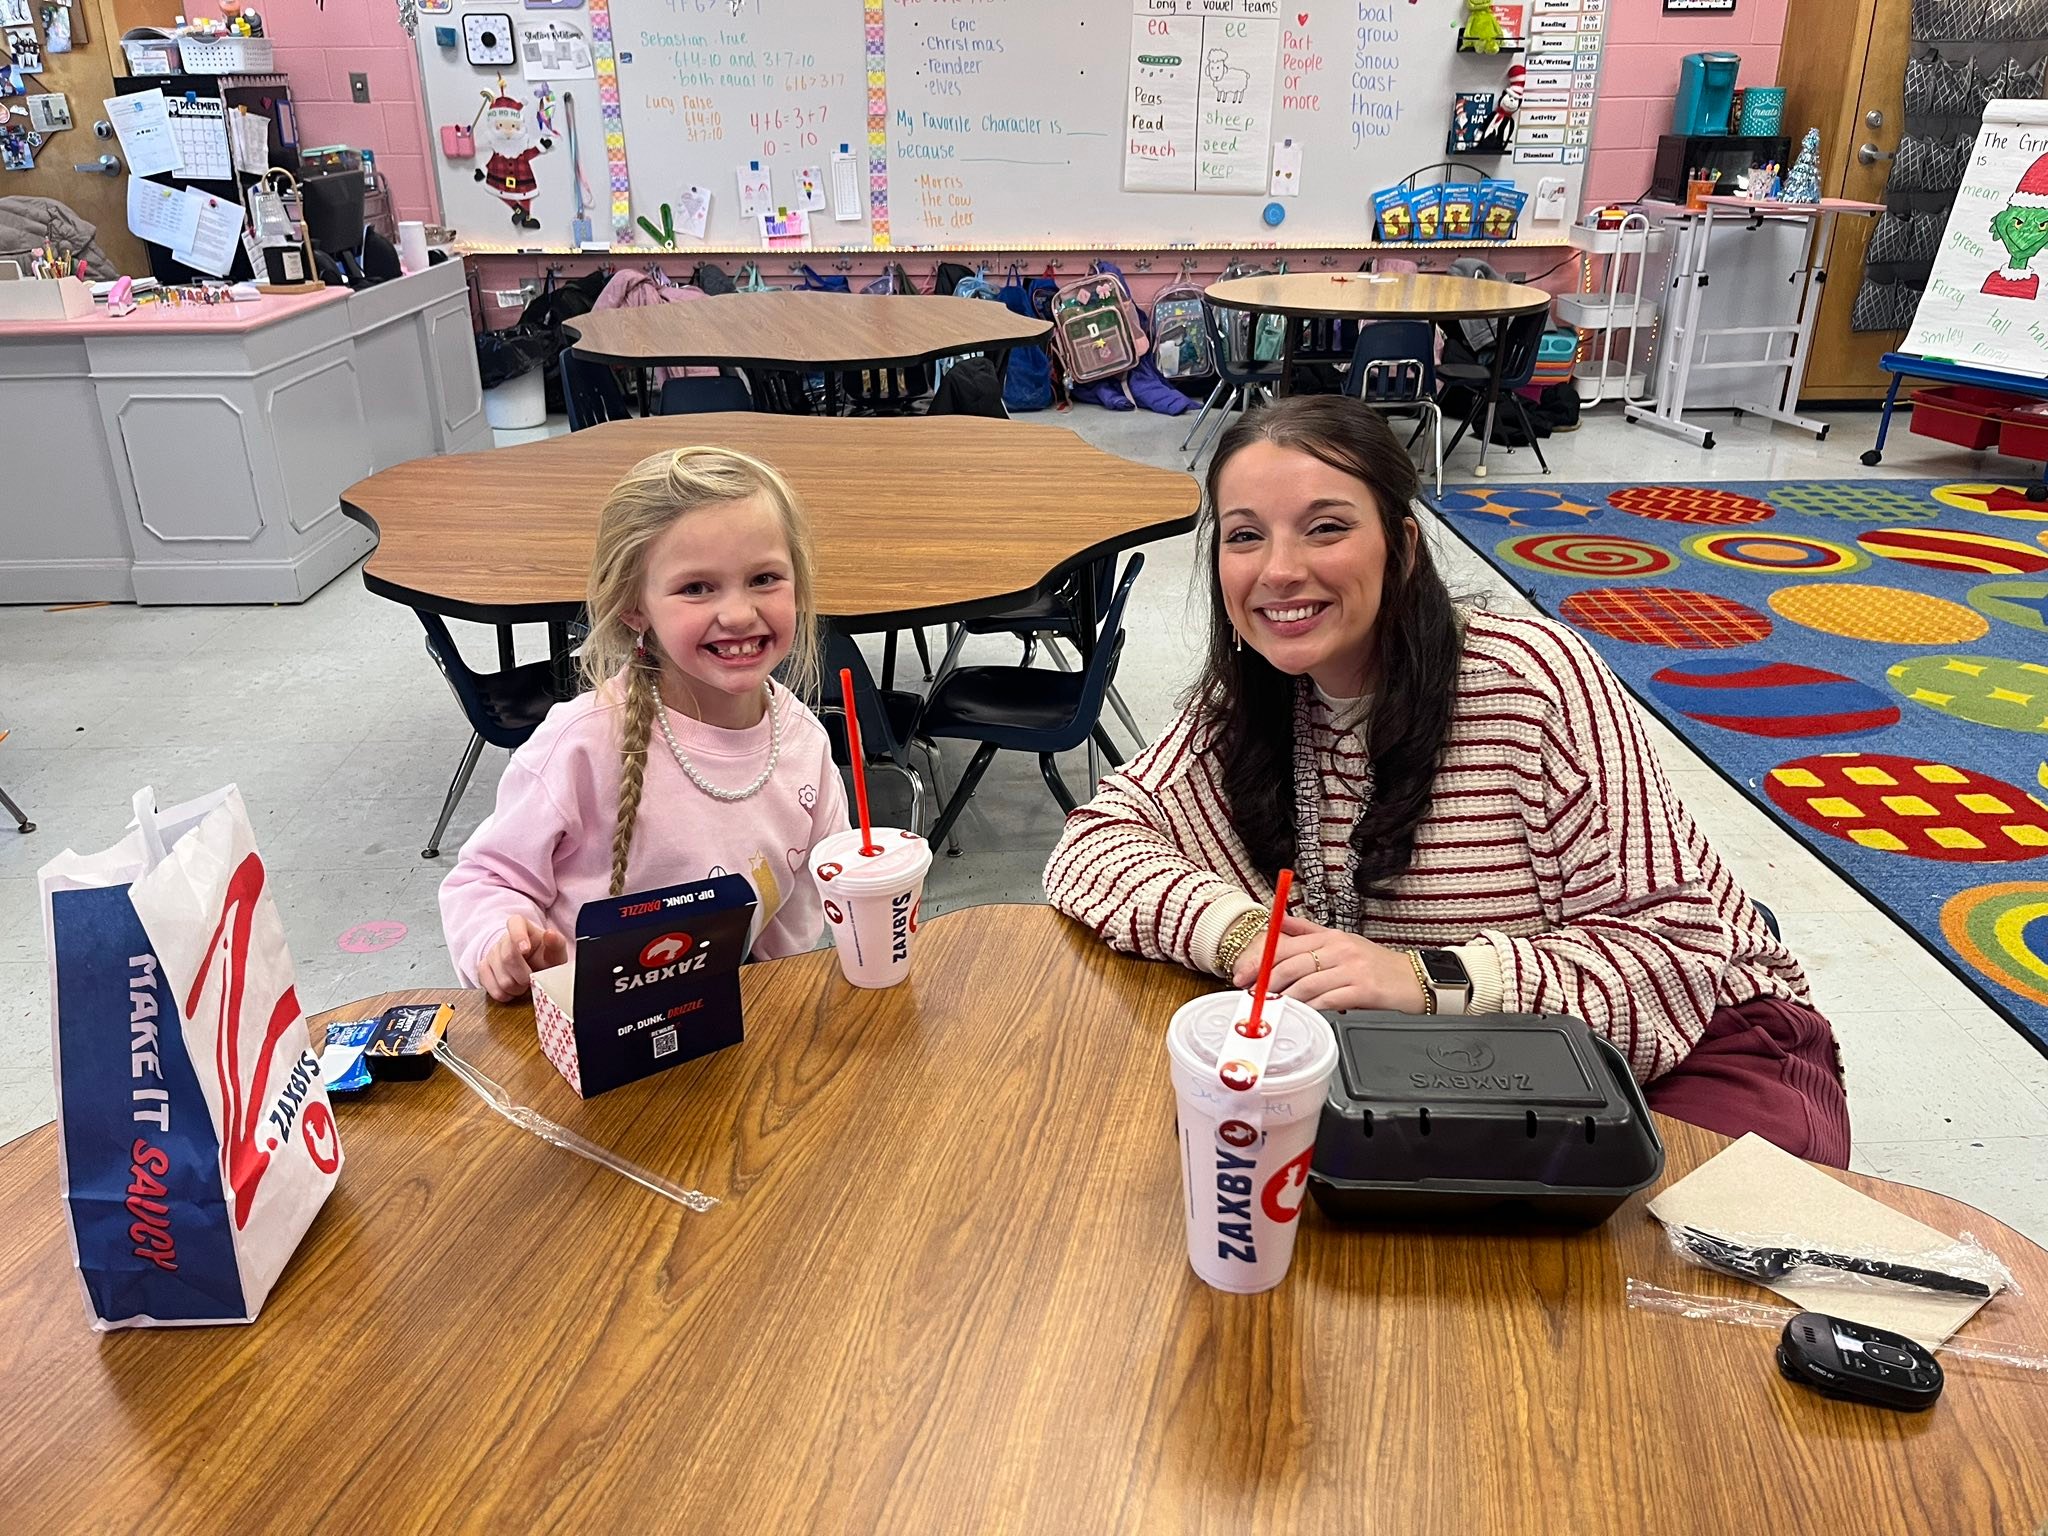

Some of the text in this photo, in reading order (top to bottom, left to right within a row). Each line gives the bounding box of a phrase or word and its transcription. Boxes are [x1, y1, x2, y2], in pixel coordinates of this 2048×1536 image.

[952, 17, 976, 32] Epic
[1148, 19, 1170, 35] ea
[1225, 22, 1247, 38] ee
[640, 31, 708, 47] Sebastian
[927, 36, 1004, 53] Christmas
[1283, 30, 1313, 50] Part
[1357, 27, 1399, 51] grow
[729, 51, 756, 67] and
[929, 56, 983, 74] reindeer
[680, 69, 714, 87] both
[720, 71, 756, 90] equal
[929, 80, 961, 96] elves
[1284, 75, 1301, 90] or
[180, 101, 220, 110] DECEMBER
[1283, 95, 1320, 111] more
[1351, 93, 1404, 120] throat
[1474, 94, 1491, 102] CAT
[1206, 110, 1254, 130] sheep
[1752, 107, 1778, 116] treats
[897, 109, 914, 136] My
[1132, 115, 1164, 131] read
[1204, 136, 1238, 152] seed
[1352, 121, 1391, 150] glow
[1984, 132, 2008, 149] The
[897, 141, 955, 159] because
[1131, 139, 1176, 157] beach
[920, 175, 963, 189] Morris
[1963, 184, 2000, 201] mean
[923, 210, 974, 228] the deer
[1948, 231, 1984, 258] green
[1986, 308, 2012, 337] tall
[1920, 327, 1965, 344] smiley
[662, 893, 695, 907] DUNK.
[695, 889, 715, 901] DIP.
[892, 890, 912, 963] ZAXBYS
[614, 952, 708, 993] ZAXBYS
[618, 1024, 636, 1036] DIP.
[637, 1013, 666, 1029] DUNK.
[1409, 1072, 1533, 1091] ZAXBYS
[269, 1050, 321, 1144] ZAXBYS
[125, 953, 179, 1272] MAKE IT SAUCY
[1215, 1131, 1267, 1264] ZAXBY
[1808, 1363, 1827, 1376] AUDIO
